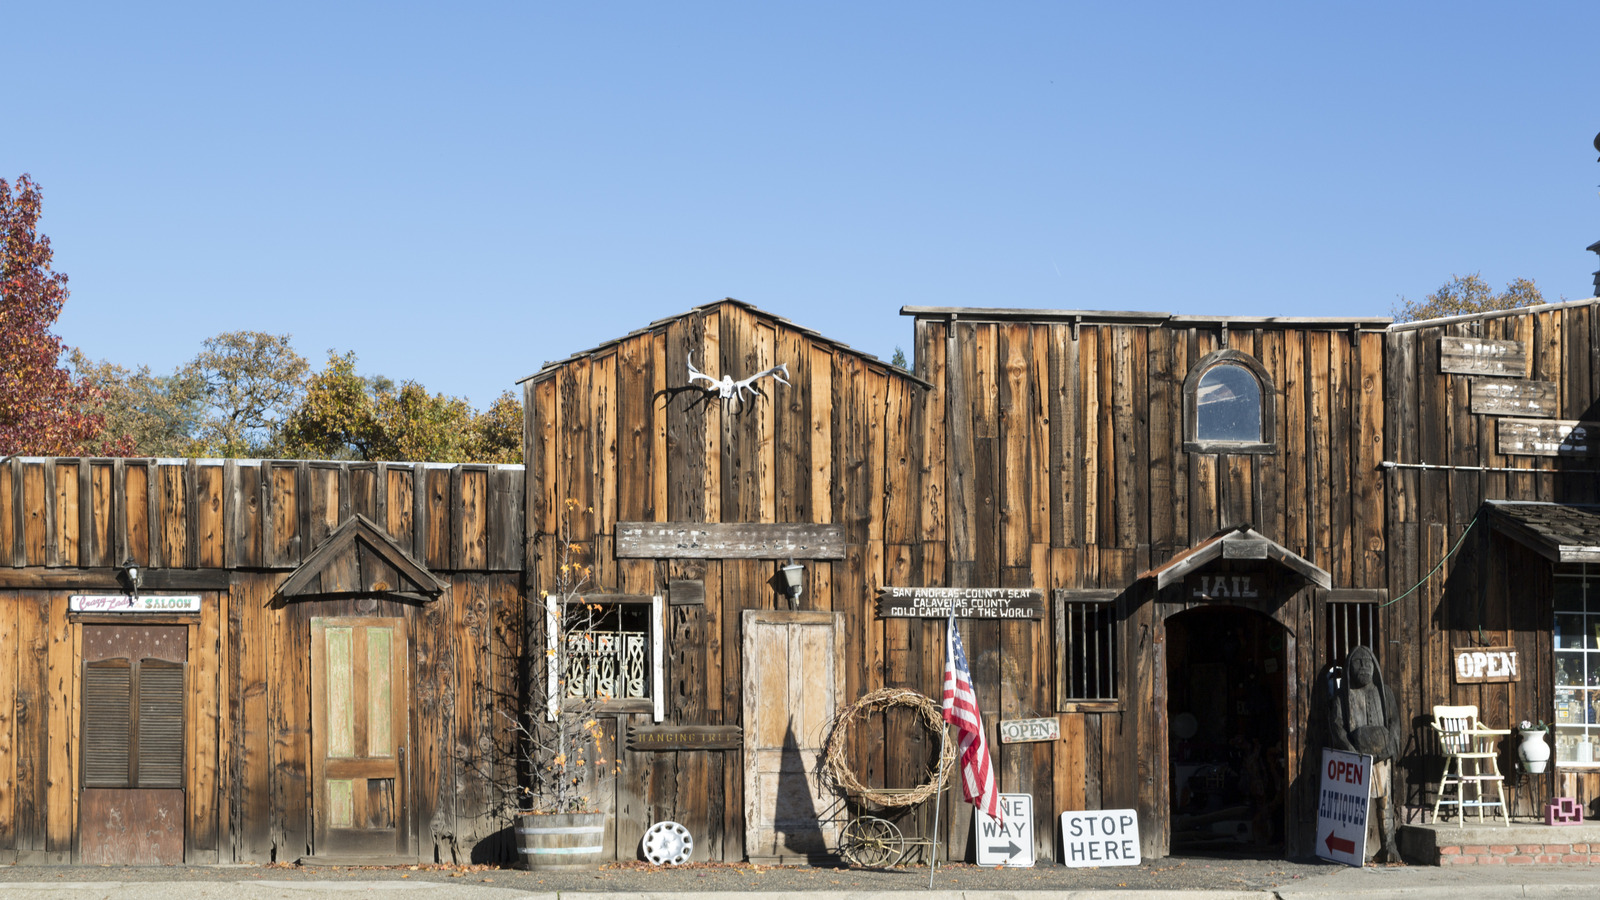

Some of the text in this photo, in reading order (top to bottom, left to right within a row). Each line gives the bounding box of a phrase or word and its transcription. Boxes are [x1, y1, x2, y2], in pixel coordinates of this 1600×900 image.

[892, 588, 911, 598] SAN
[1008, 589, 1032, 598] SEAT
[1193, 576, 1258, 597] JAIL
[145, 598, 192, 609] SALOON
[971, 599, 1011, 608] COUNTY
[891, 607, 917, 617] GOLD
[961, 607, 974, 617] OF
[978, 607, 998, 617] THE
[1000, 607, 1034, 618] WORLD
[1457, 652, 1517, 678] OPEN
[638, 733, 696, 742] HANGING
[1008, 723, 1050, 738] OPEN
[1327, 760, 1364, 785] OPEN
[1000, 801, 1025, 817] NE
[1320, 789, 1366, 828] ANTIQUES
[983, 822, 1026, 838] WAY
[1070, 816, 1133, 837] STOP
[1070, 840, 1135, 861] HERE
